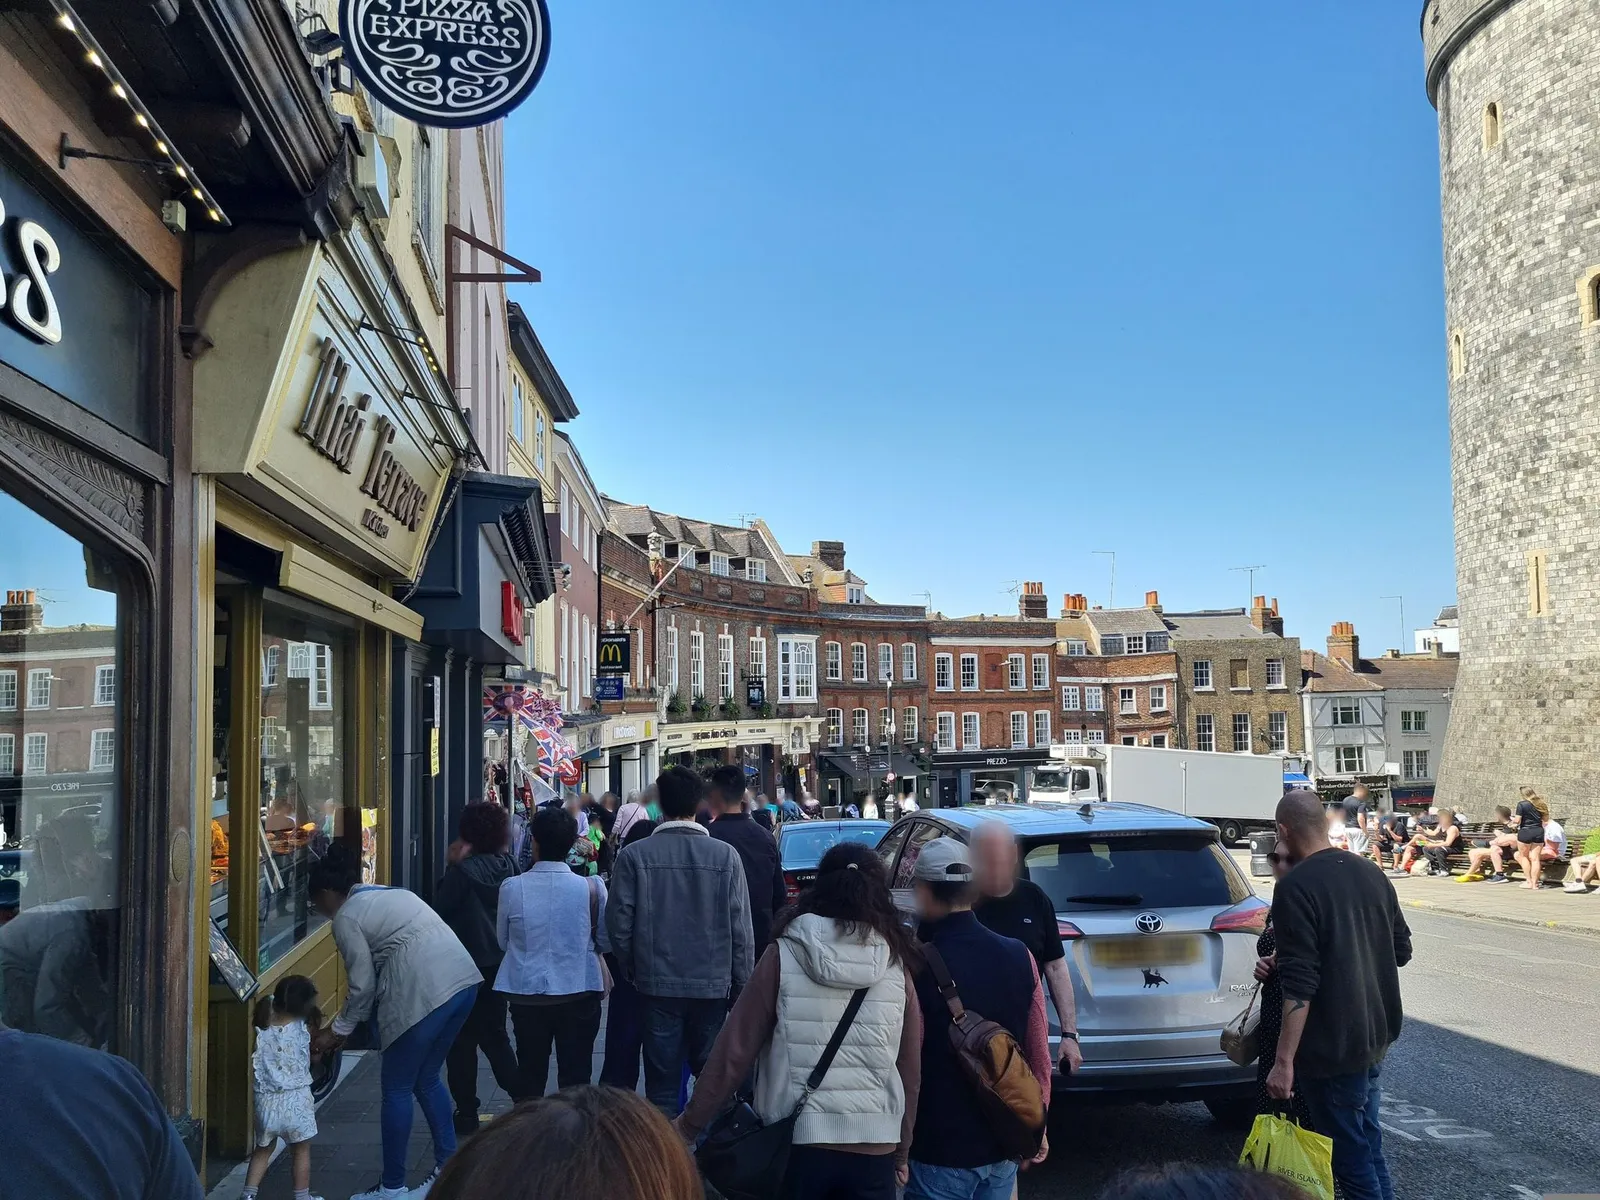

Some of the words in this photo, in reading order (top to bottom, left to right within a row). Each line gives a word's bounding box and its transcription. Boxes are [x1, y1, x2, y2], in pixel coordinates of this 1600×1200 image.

[398, 0, 495, 24] PIZZA
[369, 13, 521, 49] EXPRESS
[299, 336, 372, 474] Thai
[986, 757, 1008, 765] PREZZO
[1277, 1166, 1295, 1178] RIVER
[1296, 1173, 1322, 1186] ISLAND
